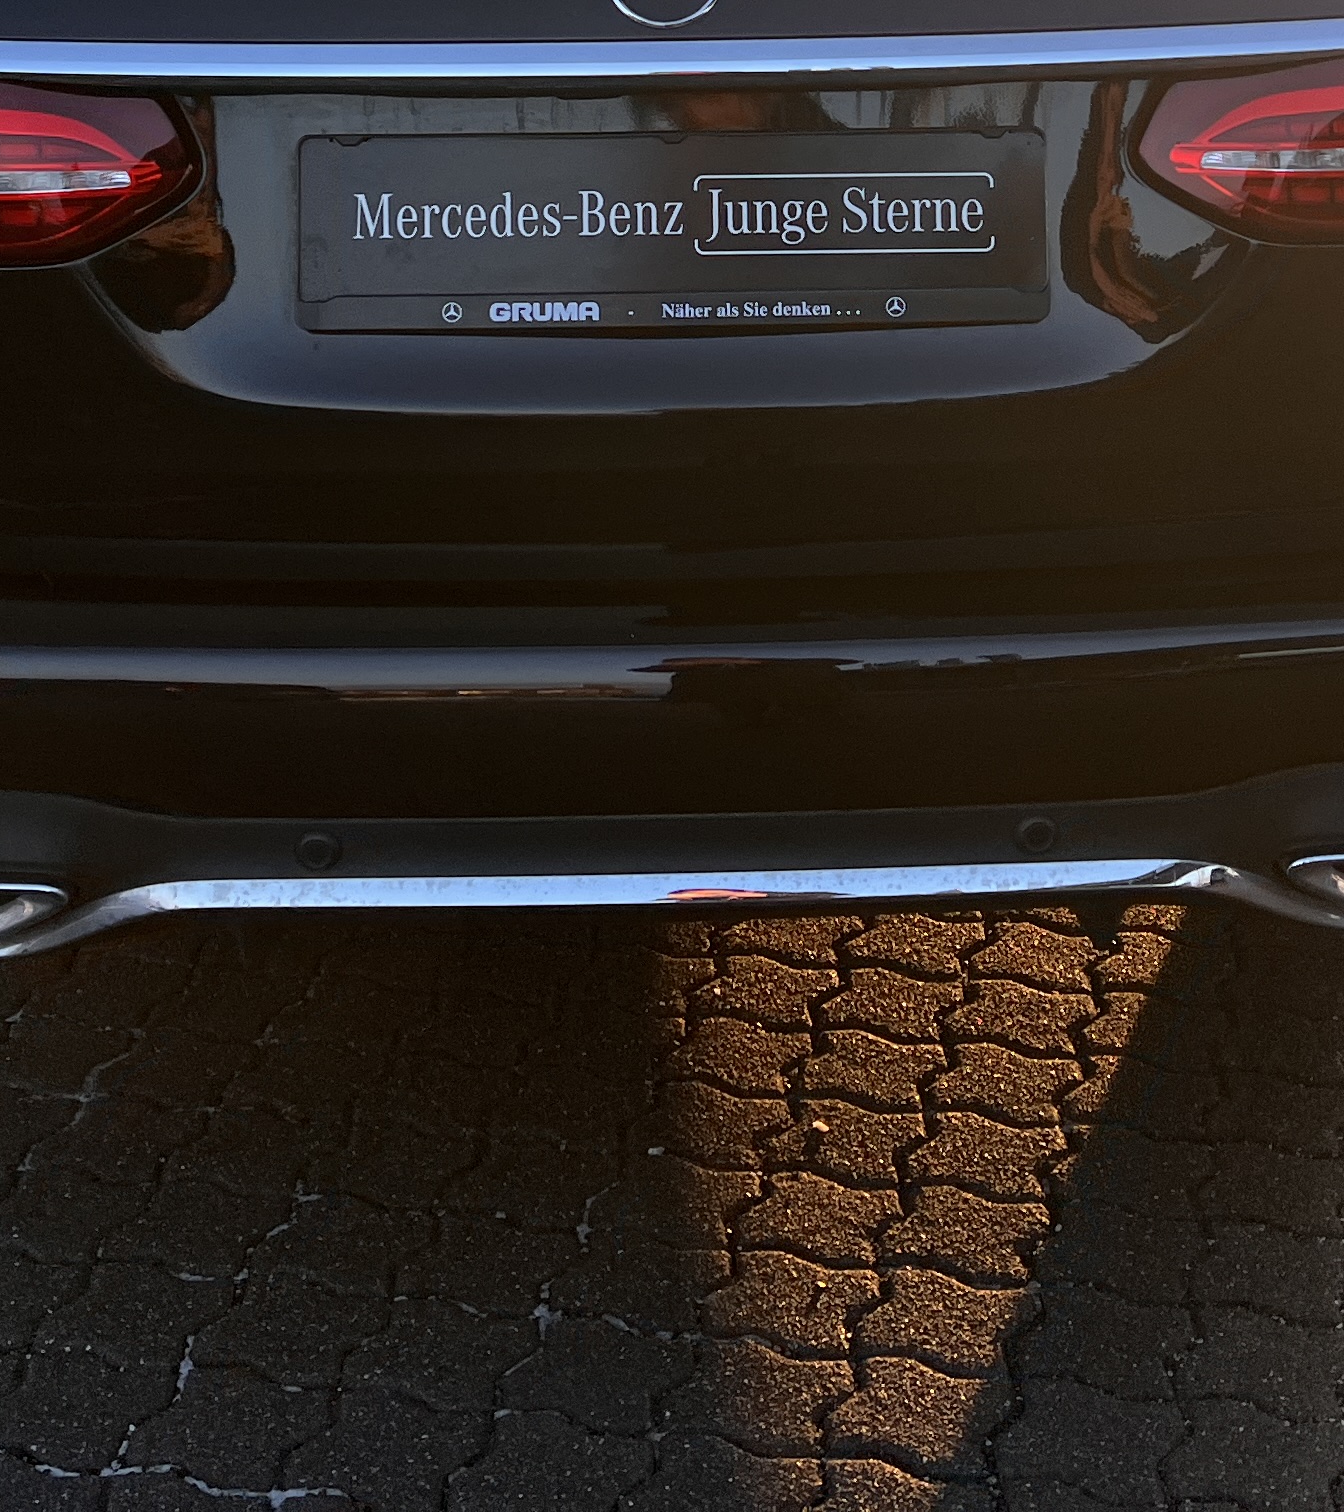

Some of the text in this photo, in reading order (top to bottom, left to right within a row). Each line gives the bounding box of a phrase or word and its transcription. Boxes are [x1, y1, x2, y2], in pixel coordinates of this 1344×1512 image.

[352, 186, 984, 245] Mercedes-Benz Junge Sterne
[489, 301, 600, 322] GRUMA
[661, 303, 712, 318] Näher
[716, 302, 739, 318] als
[743, 302, 768, 317] Sie
[772, 301, 831, 317] denken
